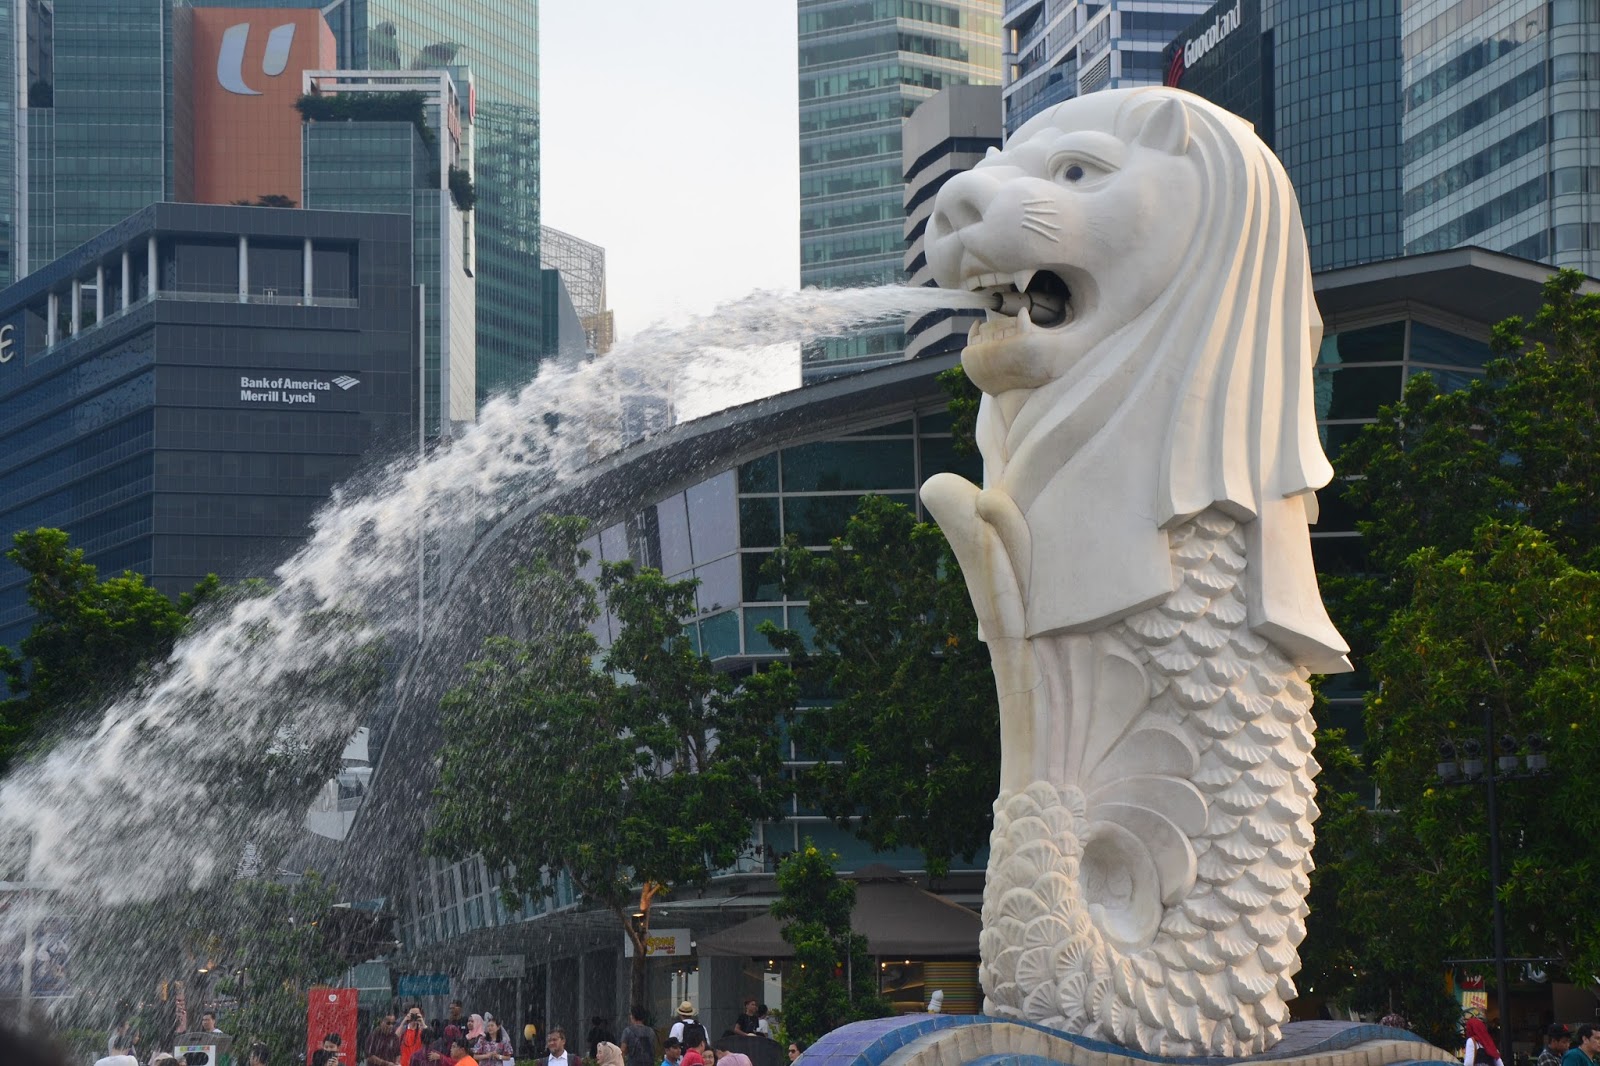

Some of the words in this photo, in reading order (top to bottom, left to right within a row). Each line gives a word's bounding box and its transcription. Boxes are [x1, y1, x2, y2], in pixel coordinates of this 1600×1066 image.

[241, 376, 270, 388] Bank
[271, 378, 283, 389] of
[284, 378, 331, 390] America
[240, 390, 279, 402] Merrill
[282, 391, 316, 404] Lynch
